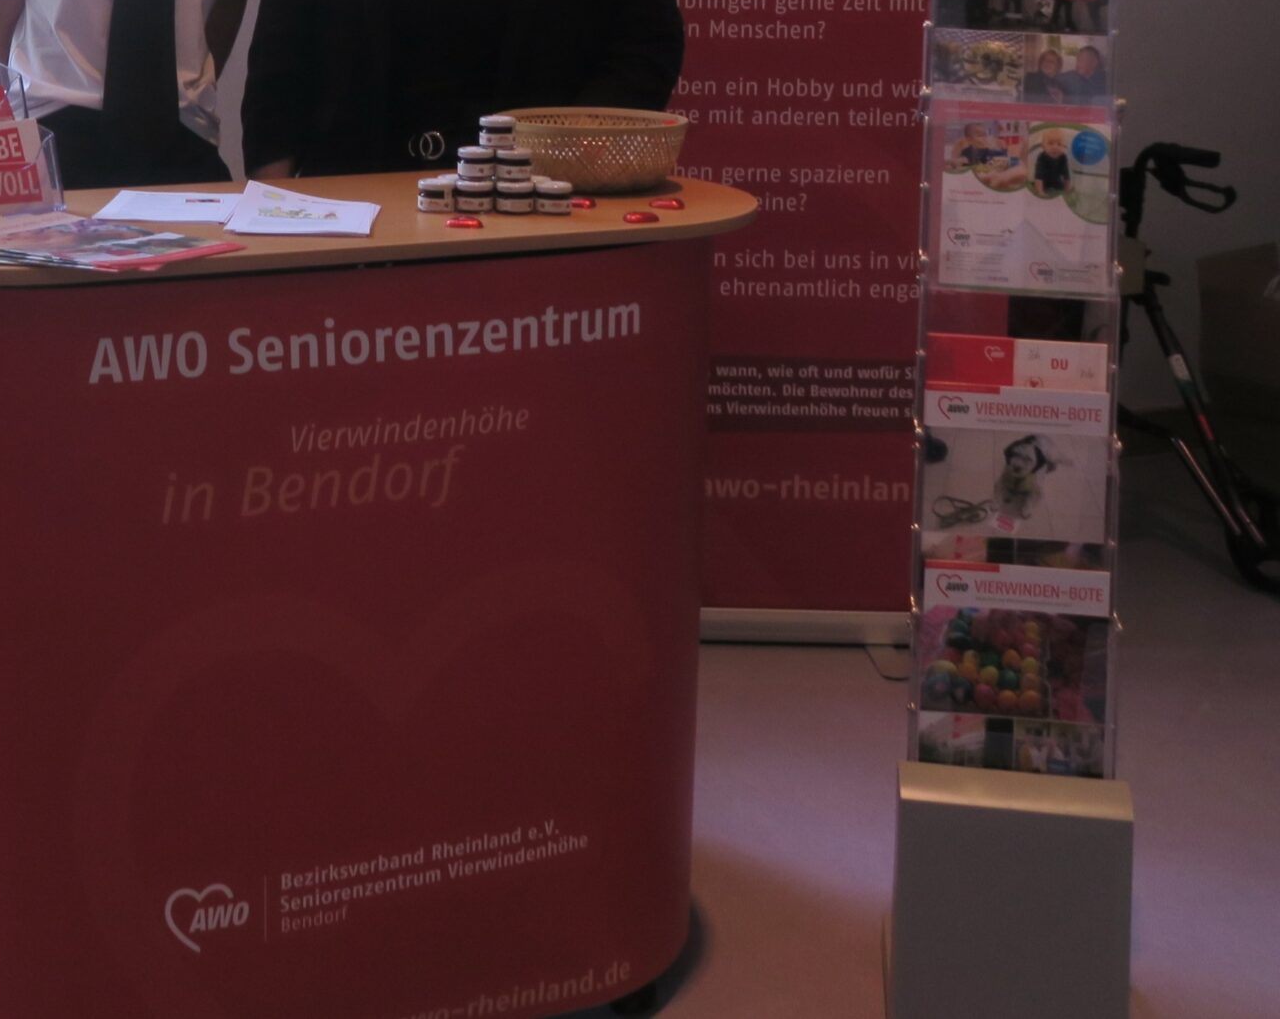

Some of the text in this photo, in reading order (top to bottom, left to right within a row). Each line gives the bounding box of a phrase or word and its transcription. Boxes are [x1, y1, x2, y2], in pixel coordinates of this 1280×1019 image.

[709, 19, 826, 40] Menschen?
[672, 76, 718, 96] ben
[725, 76, 759, 96] ein
[767, 77, 835, 102] Hobby
[842, 79, 884, 99] und
[708, 104, 745, 125] mit
[751, 106, 840, 127] anderen
[848, 107, 919, 128] teilen?
[721, 165, 782, 185] gerne
[788, 164, 890, 188] spazieren
[734, 248, 775, 269] sich
[783, 249, 816, 269] bei
[824, 252, 862, 270] uns
[870, 250, 889, 270] in
[720, 277, 861, 299] ehrenamtlich
[89, 301, 641, 385] AWO Seniorenzentrum
[715, 365, 763, 380] wann,
[767, 365, 794, 379] wie
[798, 365, 820, 379] oft
[824, 365, 853, 379] und
[857, 366, 905, 380] wofür
[1051, 358, 1068, 371] DU
[708, 383, 914, 400] möchten. Die Bewohner des
[726, 401, 847, 418] Vierwindenhöhe
[852, 403, 899, 418] freuen
[975, 401, 1103, 422] VIERWINDEN-BOTE
[289, 405, 530, 454] Vierwindenhöhe
[162, 444, 465, 524] in Bendorf
[974, 579, 1104, 602] VIERWINDEN-BOTE
[280, 819, 561, 890] Bezirksverband Rheinland e.V.
[280, 833, 589, 913] Seniorenzentrum Vierwindenhöhe
[188, 901, 250, 933] AWO
[280, 906, 351, 934] Bendorf
